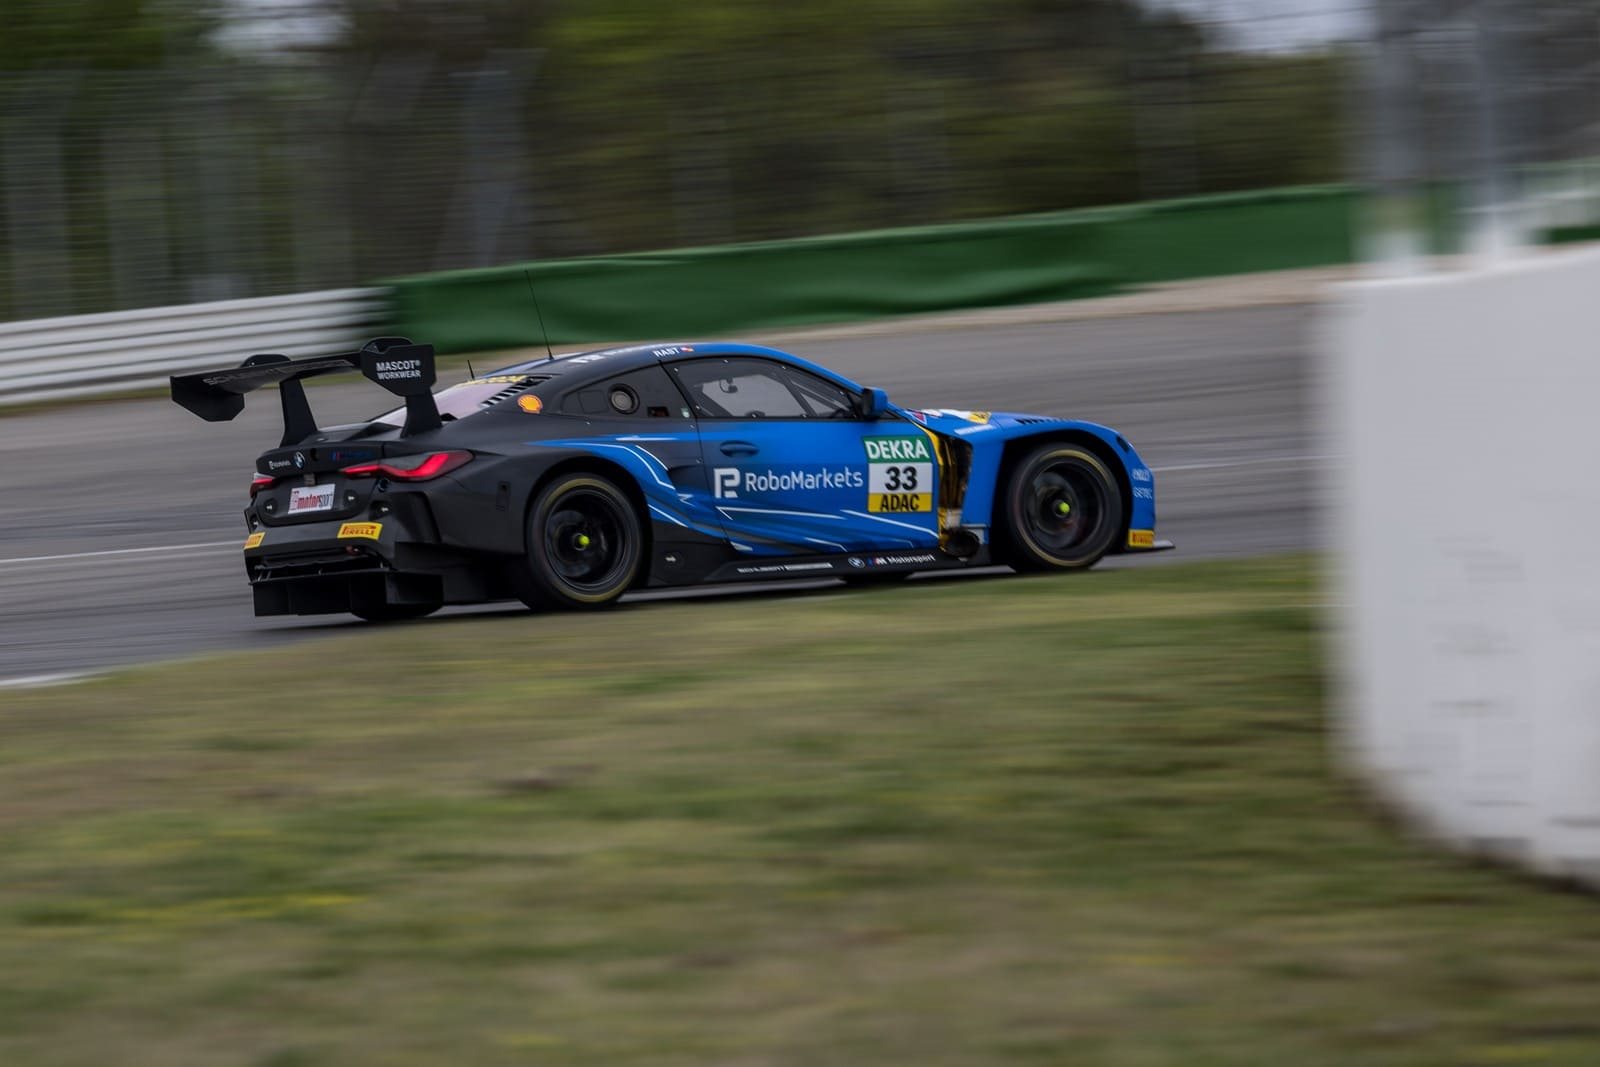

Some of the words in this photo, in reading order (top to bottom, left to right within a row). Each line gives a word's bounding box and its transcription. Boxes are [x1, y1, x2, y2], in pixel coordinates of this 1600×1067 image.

[377, 370, 421, 381] WORKWEAR
[864, 438, 930, 461] DEKRA
[745, 466, 864, 492] RoboMarkets
[884, 466, 918, 492] 33
[880, 493, 921, 512] ADAC
[342, 524, 377, 536] PIRELLI
